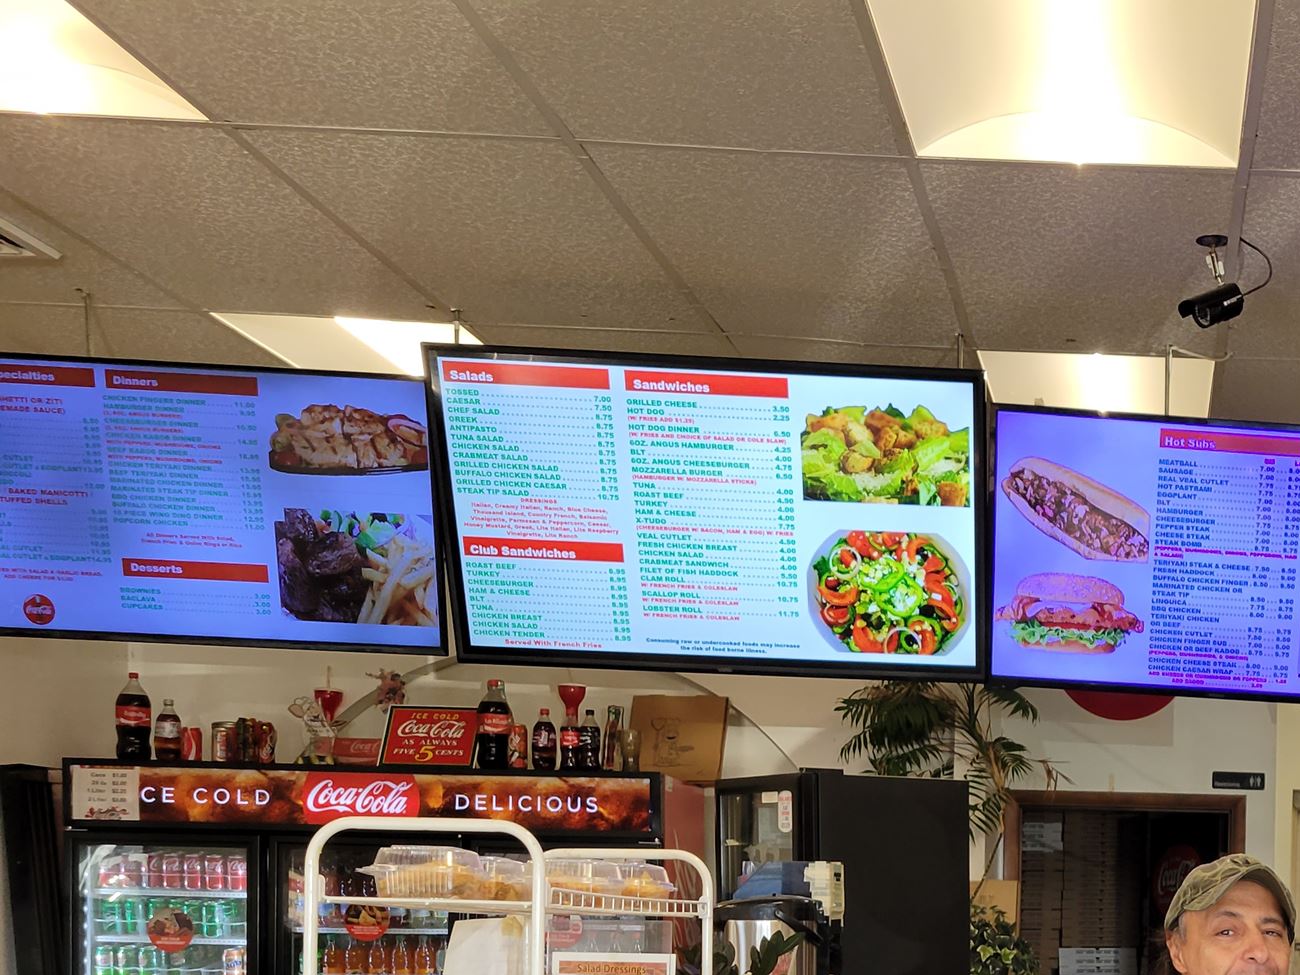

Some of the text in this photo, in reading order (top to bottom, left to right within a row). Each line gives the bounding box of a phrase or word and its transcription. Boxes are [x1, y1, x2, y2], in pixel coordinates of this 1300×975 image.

[450, 370, 494, 382] Salads
[112, 376, 158, 387] Dinners
[632, 379, 710, 393] Sandwiches
[445, 388, 480, 396] TOSSED
[626, 398, 662, 406] GRILLED
[664, 400, 698, 408] CHEESE
[447, 406, 500, 416] CHEF SALAD
[646, 408, 664, 416] DOG
[450, 424, 497, 432] ANTIPASTO
[452, 442, 520, 452] CHICKEN SALAD
[650, 440, 680, 448] ANGUS
[682, 442, 734, 450] HAMBURGER
[1165, 436, 1216, 449] Hot Subs
[452, 452, 499, 460] CRABMEAT
[630, 448, 646, 456] BLT
[454, 460, 559, 472] GRILLED CHICKEN SALAD
[1158, 458, 1198, 467] MEATBALL
[632, 466, 687, 475] MOZZARELLA
[470, 544, 577, 559] Club Sandwiches
[130, 562, 183, 574] Desserts
[468, 578, 534, 588] CHEESEBURGER
[474, 629, 545, 638] CHICKEN TENDER
[411, 712, 428, 720] ICE
[397, 720, 466, 738] Coca-Cola
[414, 746, 436, 762] 5
[140, 786, 176, 804] CE
[193, 787, 270, 806] COLD
[306, 780, 413, 816] Coca-Cola
[454, 794, 599, 814] DELICIOUS
[577, 964, 647, 975] Salad Dressings
